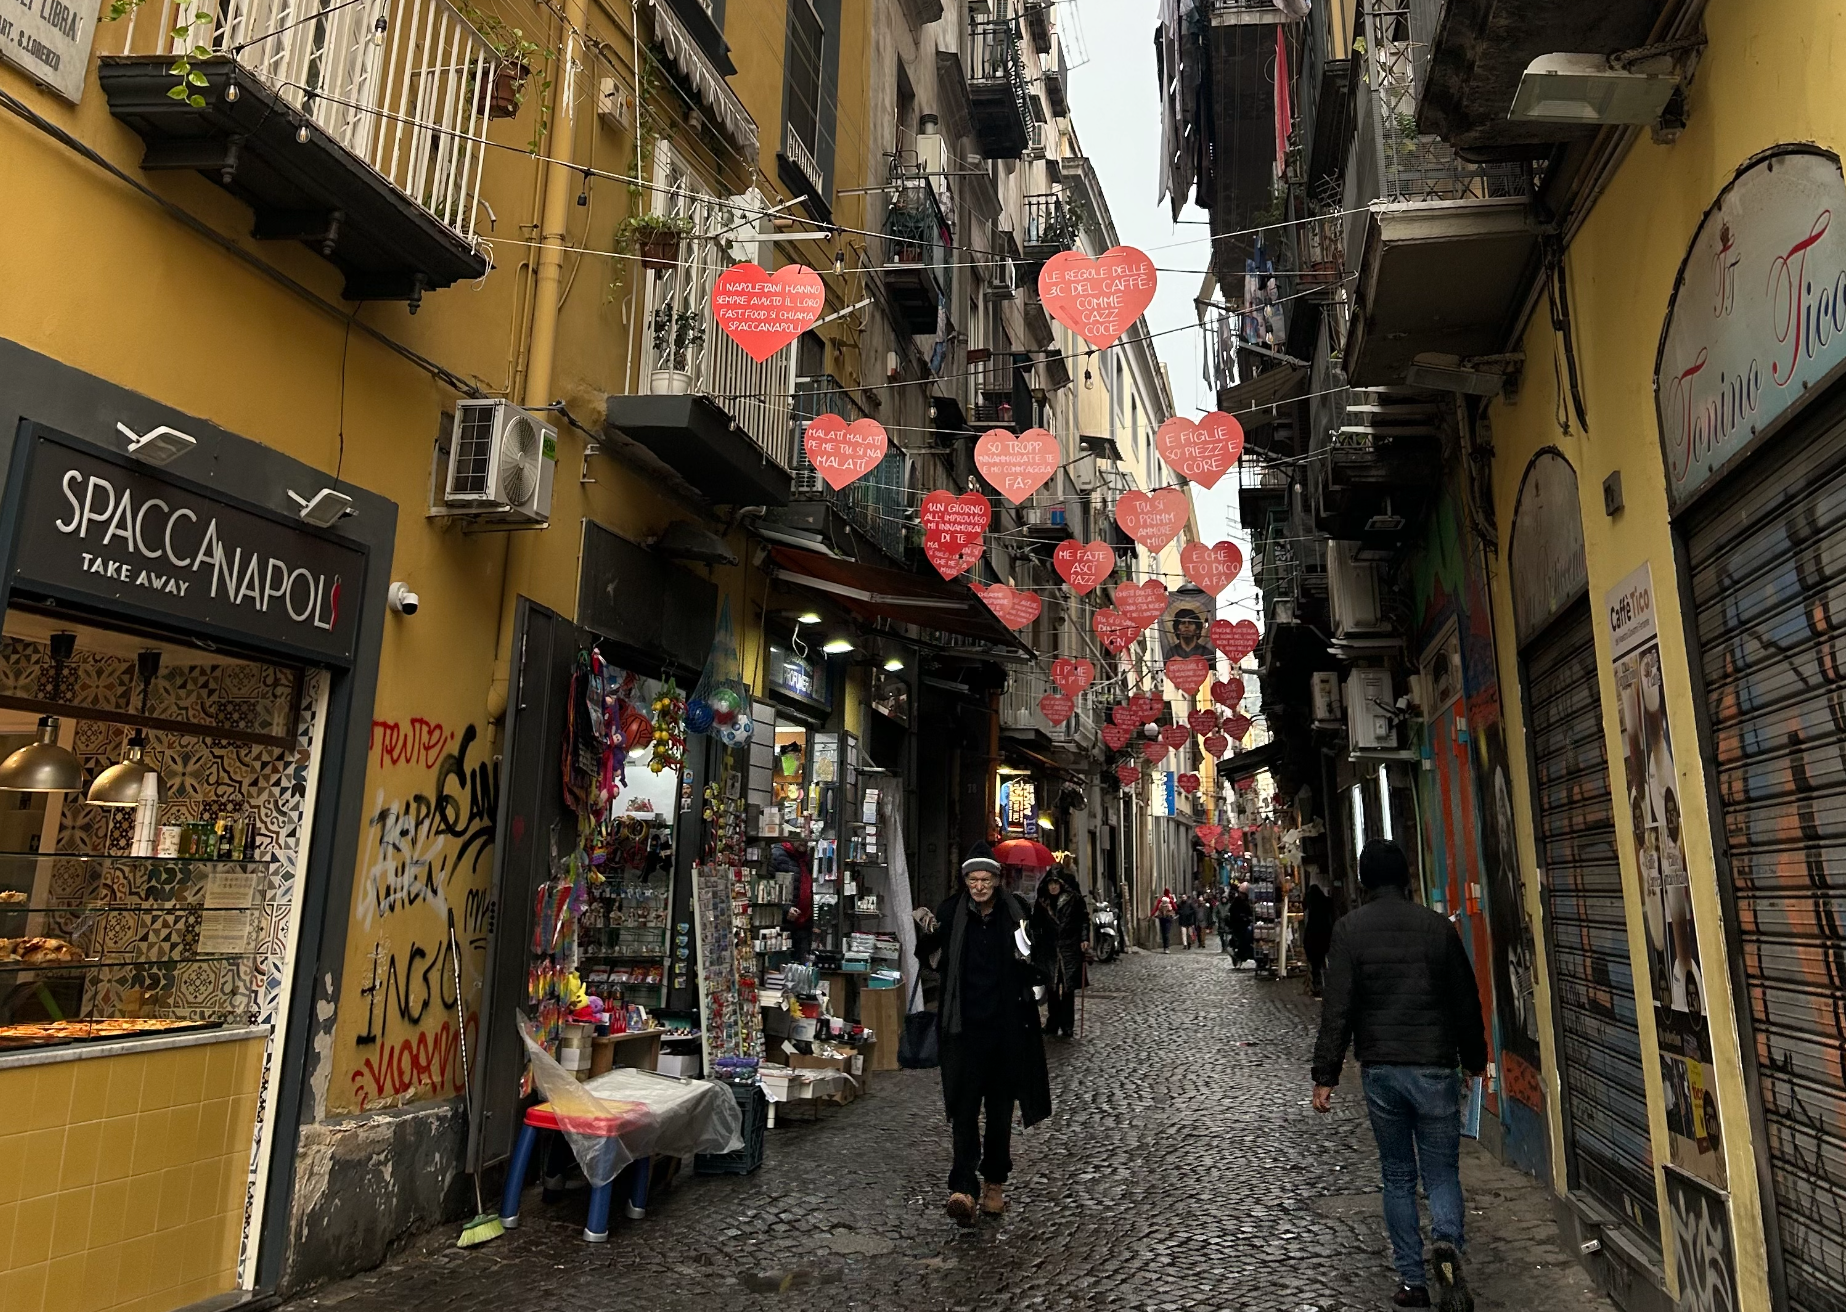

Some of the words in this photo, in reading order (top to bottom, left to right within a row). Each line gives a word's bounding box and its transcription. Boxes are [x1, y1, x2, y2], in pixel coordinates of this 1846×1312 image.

[0, 15, 15, 43] RT.
[1045, 270, 1060, 282] LE
[1065, 266, 1108, 280] REGOLE
[1112, 262, 1148, 276] DELLE
[786, 284, 820, 294] HANNO
[1045, 284, 1066, 298] 3C
[1071, 282, 1098, 296] DEL
[716, 295, 748, 305] SEMPRE
[750, 297, 782, 306] AVUTO
[798, 298, 820, 307] LORO
[1076, 293, 1124, 310] COMME
[720, 309, 744, 318] FAST
[745, 310, 768, 319] FOOD
[780, 310, 814, 320] CHIAMA
[1082, 309, 1119, 323] CAZZ
[728, 321, 802, 333] SPACCANAPOLI
[1084, 322, 1120, 336] COCE
[1668, 346, 1764, 483] Tonino
[1166, 433, 1176, 446] E
[1180, 425, 1229, 444] FIGLIE
[808, 440, 820, 450] PE
[822, 442, 836, 452] ME
[838, 444, 854, 455] TU
[866, 448, 882, 458] NA
[988, 442, 1002, 454] SO
[1005, 441, 1042, 454] TROPP
[983, 466, 989, 474] E
[927, 502, 945, 512] UN
[948, 502, 984, 514] GIORNO
[1132, 500, 1152, 513] TU
[944, 512, 986, 524] IMPROVVISO
[927, 520, 936, 530] MI
[938, 521, 982, 532] INNAMORAI
[1138, 524, 1173, 537] AMMORE
[940, 532, 951, 542] DI
[954, 533, 968, 544] TE
[1146, 534, 1166, 546] MIO
[1058, 549, 1074, 560] ME
[1192, 550, 1202, 562] E
[1204, 550, 1228, 560] CHE
[1212, 561, 1240, 574] DICO
[81, 552, 132, 583] TAKE
[135, 569, 190, 598] AWAY
[1070, 574, 1096, 585] PAZZ
[1202, 577, 1211, 586] A
[1610, 594, 1632, 632] Caffè
[1630, 586, 1650, 618] Tico
[1077, 676, 1088, 686] TE
